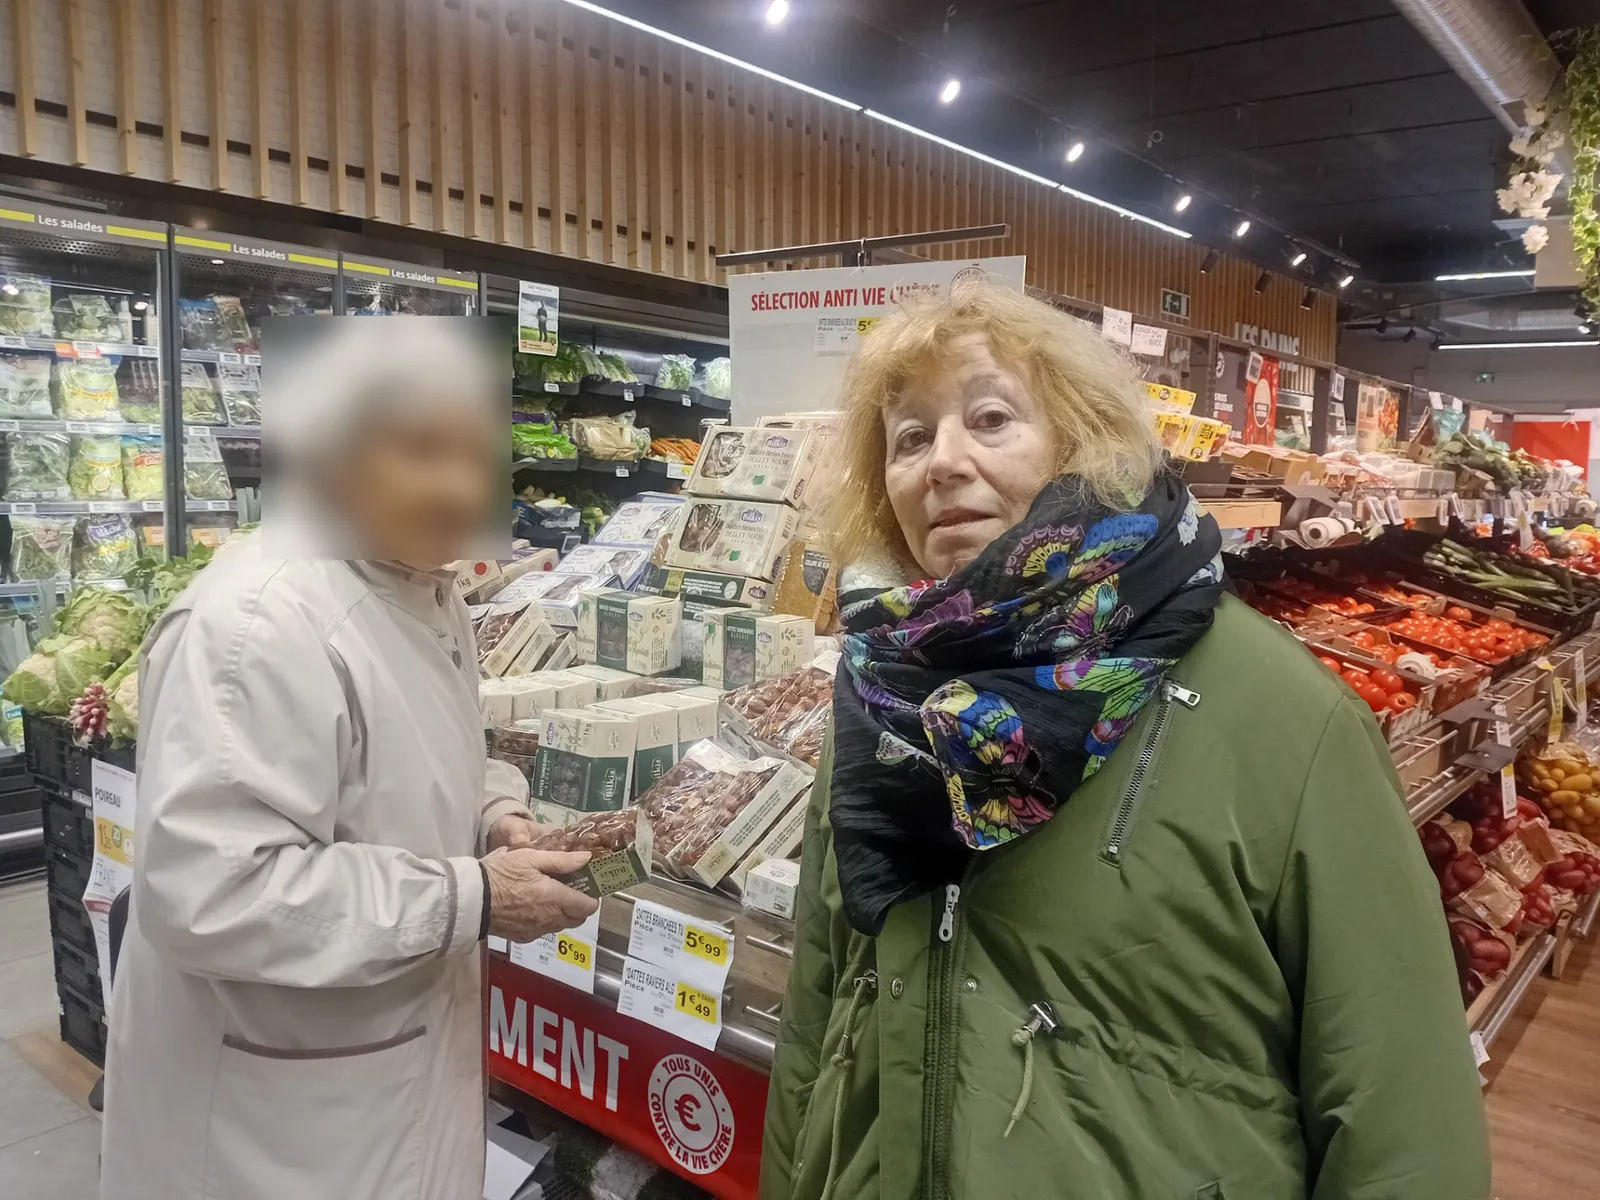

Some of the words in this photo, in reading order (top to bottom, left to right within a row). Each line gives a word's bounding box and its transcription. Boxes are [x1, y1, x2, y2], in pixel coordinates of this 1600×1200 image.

[38, 214, 58, 226] Les
[60, 219, 104, 233] salades
[233, 244, 250, 255] Les
[251, 247, 286, 260] salades
[391, 269, 406, 279] Les
[405, 271, 435, 284] salades
[751, 290, 819, 312] SÉLECTION
[823, 288, 857, 308] ANTI
[861, 287, 886, 306] VIE
[456, 578, 472, 589] 1kg
[605, 768, 616, 799] Bilkis
[95, 787, 121, 808] POIREAU
[600, 865, 627, 879] Bilkis
[633, 920, 654, 933] Pièce
[624, 979, 645, 992] Pièce
[490, 985, 629, 1113] MENT
[661, 1057, 692, 1076] TOUS
[693, 1063, 719, 1098] UNIS
[650, 1092, 675, 1149] CONTRE
[674, 1148, 691, 1165] LA
[692, 1155, 708, 1170] VIE
[711, 1122, 733, 1166] CHÈRE
